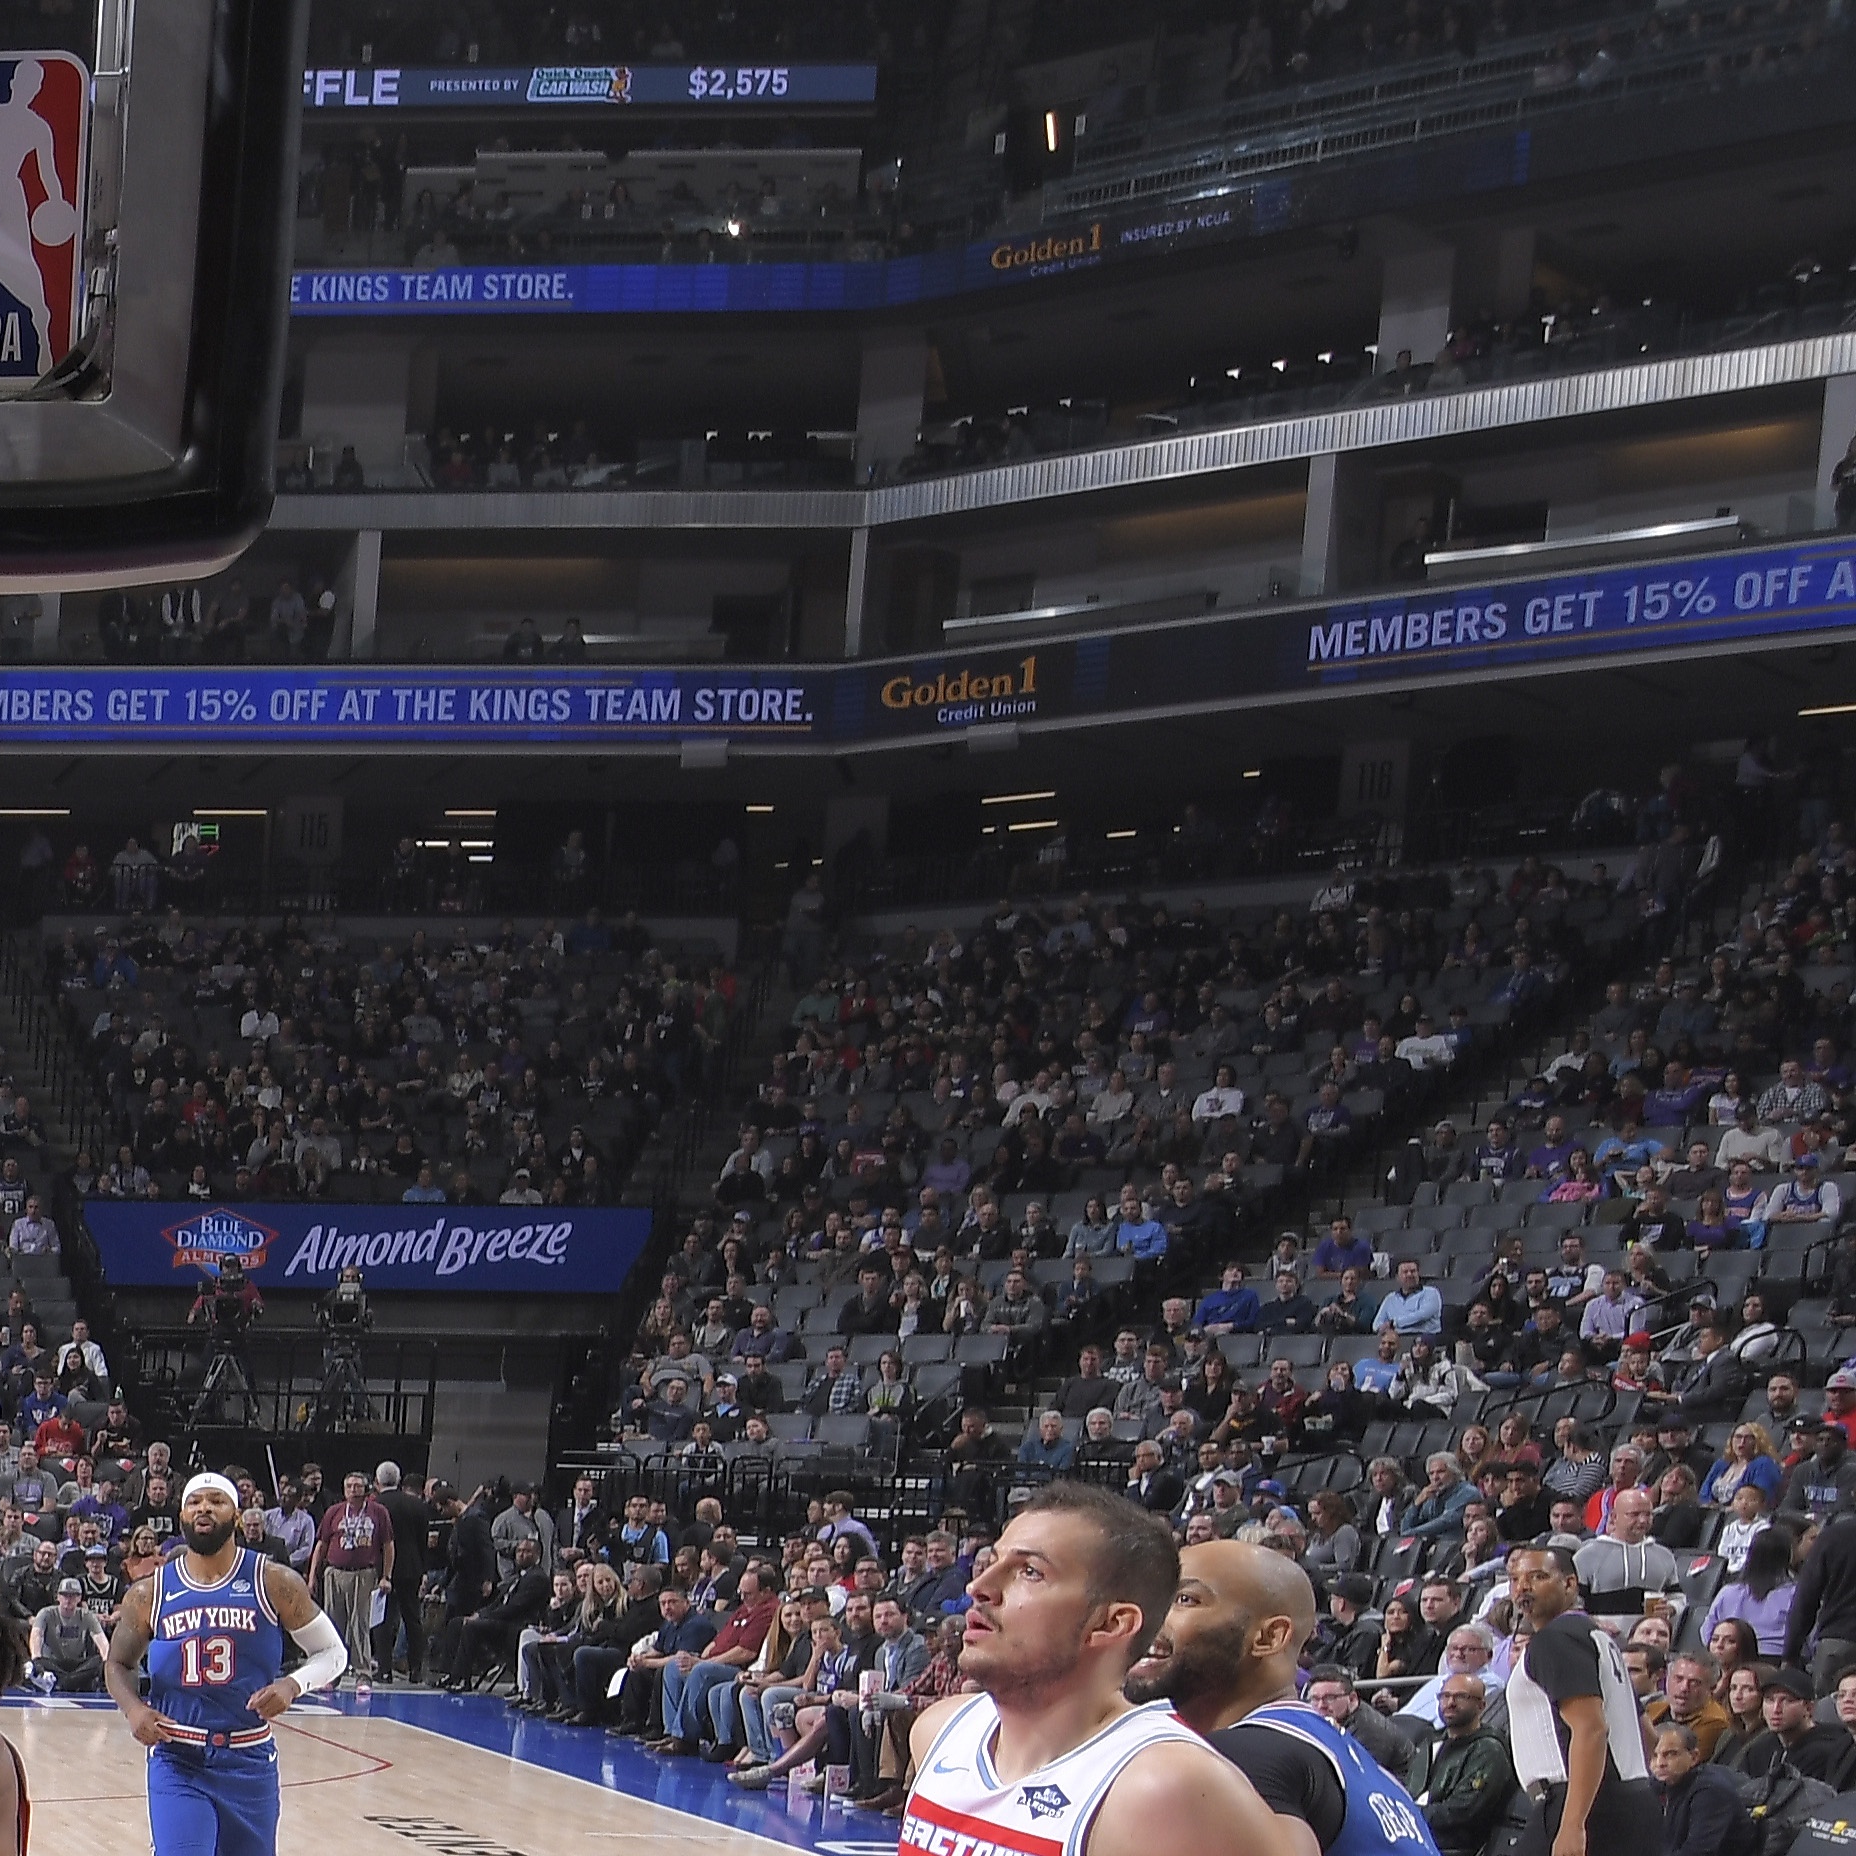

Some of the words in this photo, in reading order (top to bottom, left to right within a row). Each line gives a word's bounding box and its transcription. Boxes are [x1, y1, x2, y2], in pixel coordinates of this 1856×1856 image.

[303, 69, 401, 105] FLE
[429, 79, 500, 92] PRESENTED
[503, 79, 520, 92] BY
[539, 81, 568, 95] CAR
[569, 80, 609, 95] WASH
[688, 67, 789, 98] $2,575
[991, 235, 1084, 270] Golden
[310, 275, 389, 302] KINGS
[400, 274, 473, 301] TEAM
[482, 272, 575, 300] STORE.
[1307, 603, 1508, 662] MEMBERS
[1523, 589, 1605, 636] GET
[1623, 576, 1717, 623] 15%
[1732, 564, 1814, 611] OFF
[880, 669, 1014, 710] Golden
[1018, 654, 1038, 695] 1
[106, 688, 170, 722] GET
[184, 687, 258, 722] 15%
[268, 688, 330, 722] OFF
[337, 688, 382, 722] AT
[391, 688, 457, 722] THE
[467, 688, 573, 722] KINGS
[587, 688, 683, 722] TEAM
[692, 688, 814, 722] STORE.
[936, 703, 986, 724] Credit
[990, 699, 1037, 718] Union
[176, 1229, 266, 1249] DIAMOND
[200, 1216, 244, 1234] BLUE
[161, 1607, 203, 1640] NEW
[204, 1605, 258, 1632] YORK
[181, 1633, 236, 1688] 13
